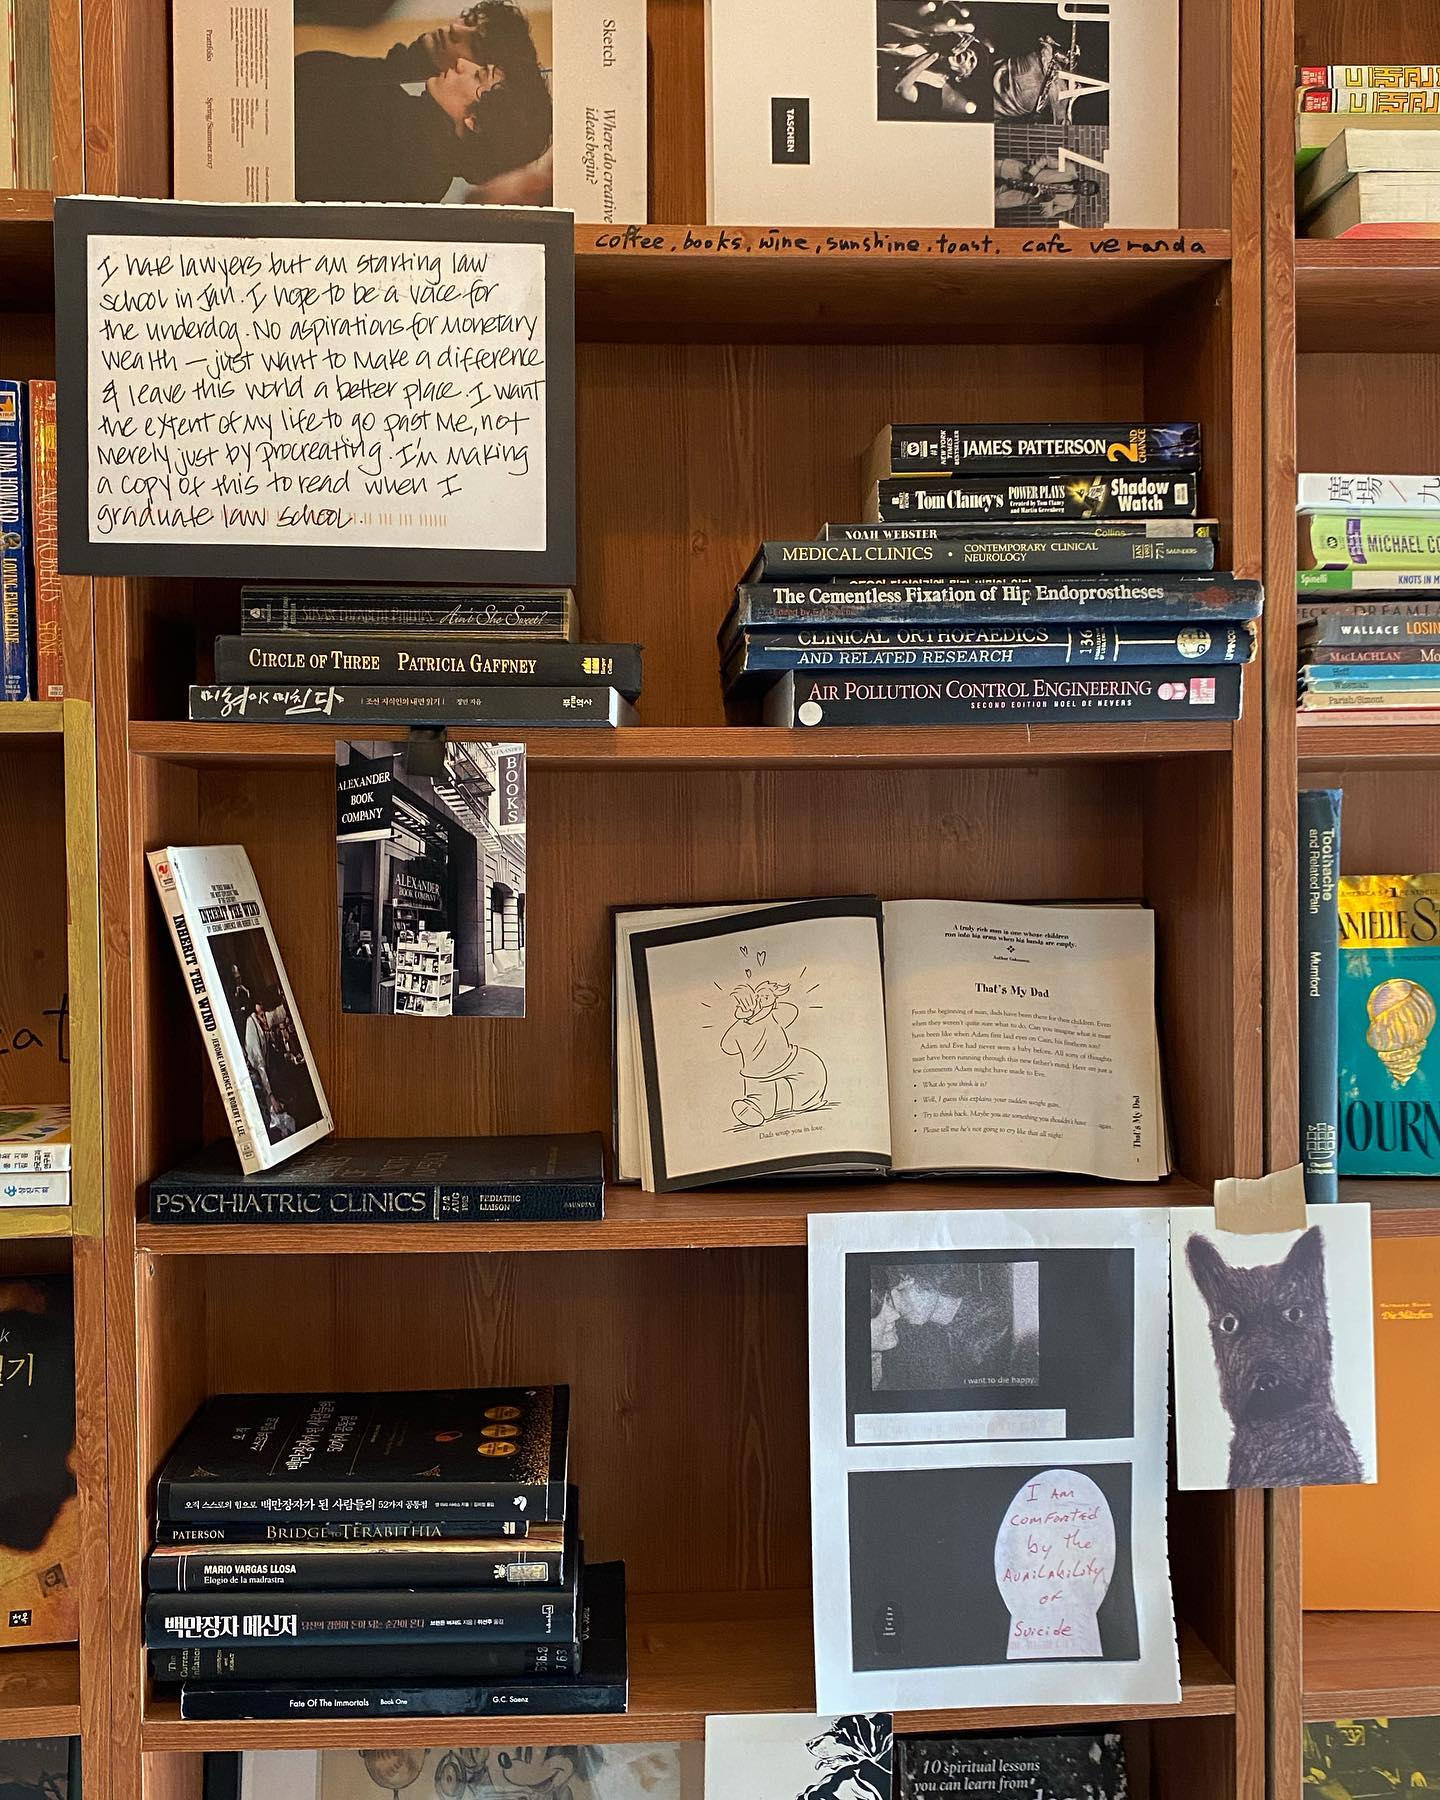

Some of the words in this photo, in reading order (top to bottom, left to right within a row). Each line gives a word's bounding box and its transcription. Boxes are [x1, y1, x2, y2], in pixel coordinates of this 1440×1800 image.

[602, 18, 617, 68] Sketch
[585, 106, 600, 142] ideas
[603, 108, 617, 152] Where
[785, 107, 796, 154] TASCHEN
[581, 142, 600, 185] begin?
[603, 152, 617, 171] do
[603, 171, 617, 224] creative
[1021, 232, 1073, 254] cafe
[97, 255, 119, 287] I
[126, 254, 174, 276] hate
[180, 254, 262, 287] lawyers
[269, 252, 311, 276] but
[357, 253, 441, 285] starting
[453, 252, 488, 274] law
[99, 289, 168, 312] school
[175, 288, 193, 308] in
[197, 283, 244, 312] Jan.
[246, 282, 267, 314] I
[273, 285, 320, 314] hope
[321, 282, 346, 305] to
[353, 282, 380, 305] be
[384, 285, 399, 303] a
[462, 278, 499, 308] for
[99, 318, 139, 340] the
[146, 315, 250, 355] underdog.
[252, 318, 281, 340] No
[290, 313, 404, 345] aspirations
[406, 312, 439, 340] for
[261, 349, 318, 372] want
[322, 348, 346, 370] to
[415, 350, 431, 369] a
[437, 345, 544, 372] difference
[0, 441, 18, 473] LINDA
[963, 440, 1012, 458] JAMES
[1018, 439, 1107, 457] PATTERSON
[1138, 428, 1147, 464] CHANCE
[1008, 486, 1038, 500] POWER
[1039, 485, 1065, 499] PLAYS
[1111, 477, 1170, 497] Shadow
[0, 476, 19, 523] HOWARD
[915, 491, 946, 510] Tom
[947, 490, 1004, 513] Clancy's
[1118, 494, 1164, 512] Watch
[845, 530, 879, 540] NOAH
[882, 529, 937, 540] WEBSTER
[1094, 528, 1126, 538] Collins
[782, 547, 862, 561] MEDICAL
[865, 546, 933, 561] CLINICS
[964, 543, 1047, 553] CONTEMPORARY
[1051, 542, 1099, 551] CLINICAL
[964, 552, 1027, 563] NEUROLOGY
[3, 558, 17, 588] LOVING
[1301, 573, 1328, 586] Spinelli
[1398, 575, 1422, 585] KNOTS
[1424, 575, 1432, 585] IN
[773, 587, 806, 604] The
[809, 587, 902, 604] Cementless
[905, 586, 977, 603] Fixation
[979, 586, 998, 602] of
[1002, 585, 1032, 606] Hip
[1036, 584, 1165, 605] Endoprostheses
[4, 592, 19, 643] EVANGELINE
[797, 628, 890, 646] CLINICAL
[897, 627, 1049, 645] ORTHOPAEDICS
[1341, 625, 1400, 635] WALLACE
[1080, 629, 1093, 654] 136
[249, 648, 305, 669] CIRCLE
[309, 654, 327, 668] OF
[330, 650, 380, 670] THREE
[398, 652, 466, 673] PATRICIA
[470, 654, 537, 674] GAFFNEY
[797, 652, 833, 664] AND
[839, 650, 916, 664] RELATED
[922, 649, 1014, 664] RESEARCH
[807, 682, 840, 701] AIR
[844, 682, 942, 700] POLLUTION
[945, 680, 1029, 699] CONTROL
[1033, 679, 1152, 698] ENGINEERING
[970, 701, 1006, 709] SECOND
[1011, 700, 1047, 708] EDITION
[1081, 700, 1092, 708] DE
[337, 771, 391, 793] ALEXANDER
[506, 756, 519, 823] BOOKS
[350, 791, 374, 806] BOOK
[341, 807, 383, 824] COMPANY
[1309, 829, 1320, 849] and
[1309, 850, 1321, 889] Related
[1322, 828, 1336, 901] Toothache
[1310, 892, 1321, 914] Pain
[173, 914, 198, 966] INHERIT
[189, 967, 206, 996] THE
[198, 995, 217, 1032] WIND
[1308, 951, 1321, 997] Mumford
[975, 982, 1007, 995] That's
[1011, 985, 1027, 998] My
[1031, 987, 1049, 998] Dad
[156, 1193, 321, 1214] PSYCHIATRIC
[330, 1192, 426, 1213] CLINICS
[184, 1500, 200, 1509] 오직
[202, 1500, 232, 1510] 스스로의
[234, 1500, 258, 1509] 힘으로
[261, 1498, 315, 1511] 백만장자가
[318, 1498, 329, 1511] 된
[332, 1498, 375, 1511] 사람들의
[378, 1500, 404, 1510] 52가지
[405, 1499, 428, 1509] 공통점
[172, 1530, 225, 1540] PATERSON
[267, 1525, 328, 1539] BRIDGE
[341, 1524, 443, 1539] TERABITHIA
[1027, 1534, 1052, 1558] by
[1064, 1529, 1094, 1550] the
[204, 1564, 233, 1574] MARIO
[234, 1564, 268, 1574] VARGAS
[270, 1564, 297, 1574] LLOSA
[204, 1576, 229, 1585] Elogio
[230, 1576, 239, 1584] de
[240, 1576, 248, 1584] la
[249, 1576, 285, 1584] madrastra
[164, 1615, 239, 1639] 백만장자
[243, 1614, 298, 1637] 메신저
[1013, 1618, 1073, 1638] Suicide
[289, 1699, 305, 1708] Fate
[307, 1699, 318, 1707] Of
[319, 1699, 332, 1707] The
[334, 1698, 369, 1708] Immortals
[923, 1759, 941, 1774] 10
[943, 1759, 996, 1778] spiritual
[998, 1759, 1040, 1772] lessons
[914, 1780, 937, 1794] you
[939, 1780, 960, 1791] can
[964, 1777, 997, 1790] learn
[997, 1775, 1029, 1793] from
